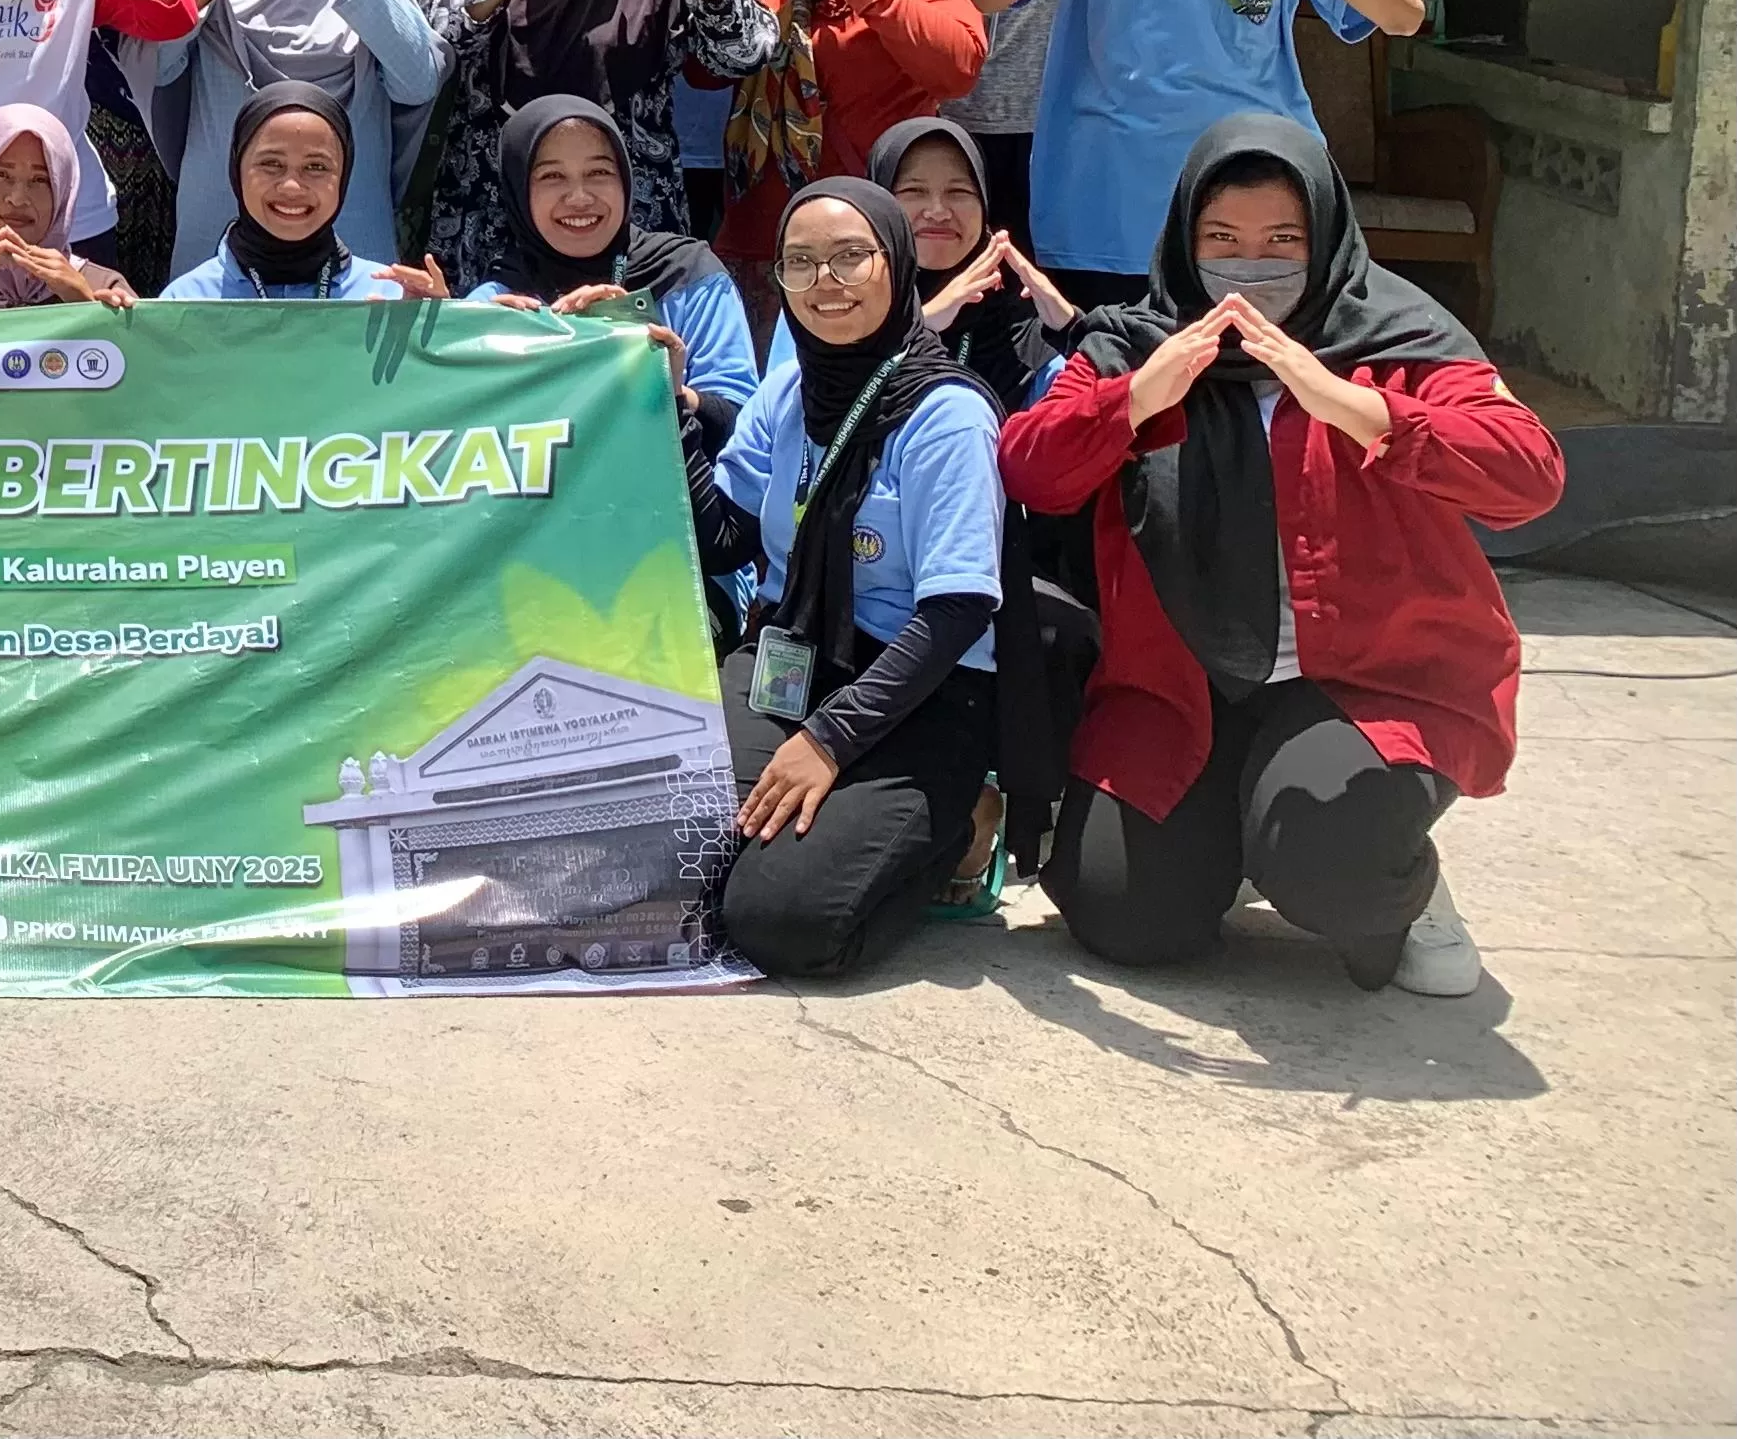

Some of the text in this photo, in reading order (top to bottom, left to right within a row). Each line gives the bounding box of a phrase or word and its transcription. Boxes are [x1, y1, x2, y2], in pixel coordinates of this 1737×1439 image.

[824, 445, 840, 470] PPKO
[836, 403, 866, 447] HIMATIKA
[863, 377, 883, 407] FMIPA
[3, 555, 168, 583] Kalurahan
[177, 554, 286, 585] Playen
[23, 623, 117, 656] Desa
[119, 615, 279, 655] Berdaya!
[466, 731, 507, 749] DAERAH
[510, 721, 562, 741] ISTIMEWA
[563, 707, 640, 730] YOGYAKARTA
[59, 852, 164, 885] FMIPA
[164, 854, 245, 883] UNY
[243, 854, 323, 885] 2025
[13, 921, 76, 940] PPKO
